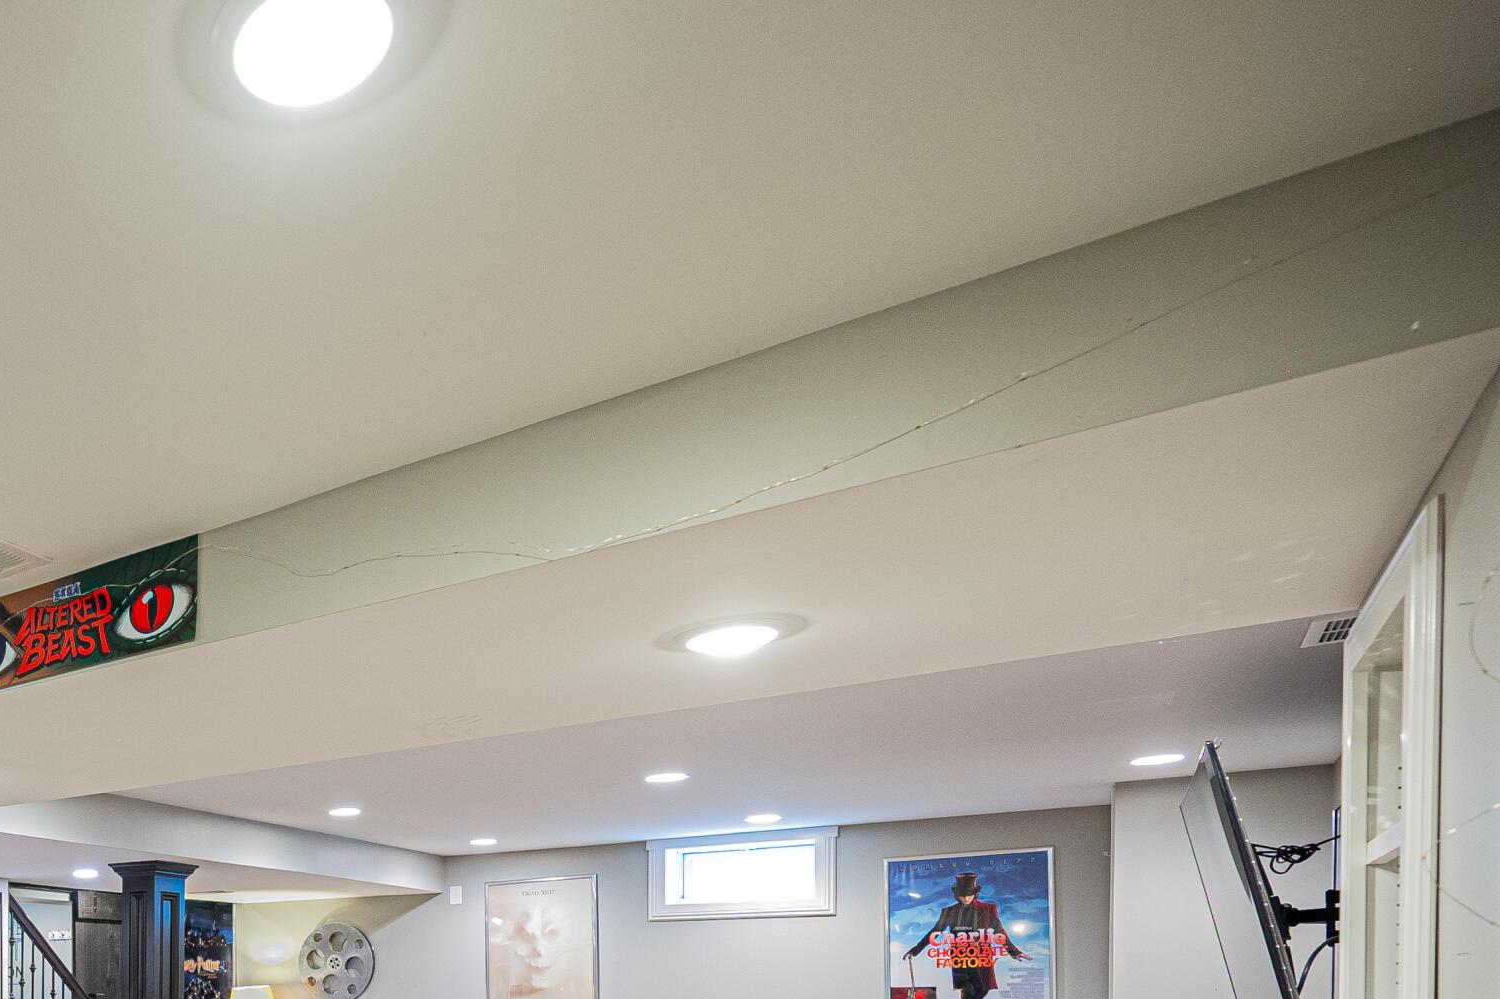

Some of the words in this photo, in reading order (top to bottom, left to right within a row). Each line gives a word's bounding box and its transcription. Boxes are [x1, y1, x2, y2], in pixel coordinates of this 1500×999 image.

[52, 581, 81, 602] SEGA
[14, 585, 113, 646] ALTERED
[16, 613, 114, 677] BEAST
[929, 927, 1007, 947] Charlie
[927, 946, 1009, 959] CHOCOLATE
[936, 957, 999, 969] FACTORY
